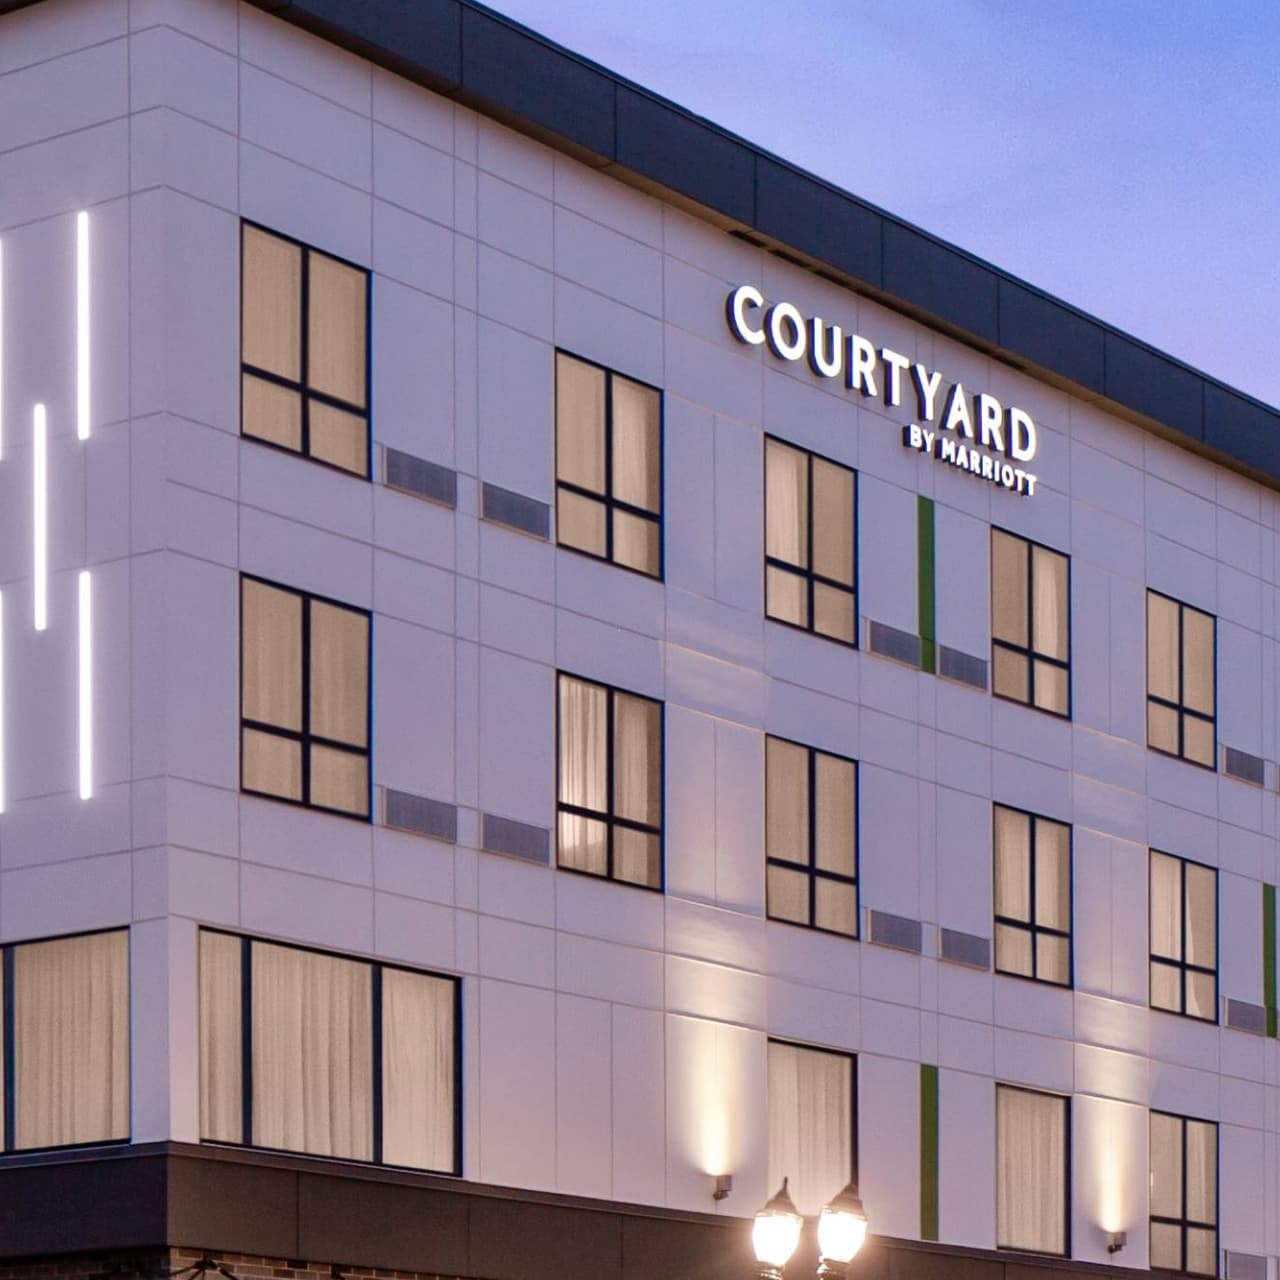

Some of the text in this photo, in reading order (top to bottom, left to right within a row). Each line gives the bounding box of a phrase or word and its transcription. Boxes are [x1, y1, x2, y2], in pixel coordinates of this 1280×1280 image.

[728, 284, 1037, 463] COURTYARD
[903, 423, 1038, 497] BY MARRIOTT
